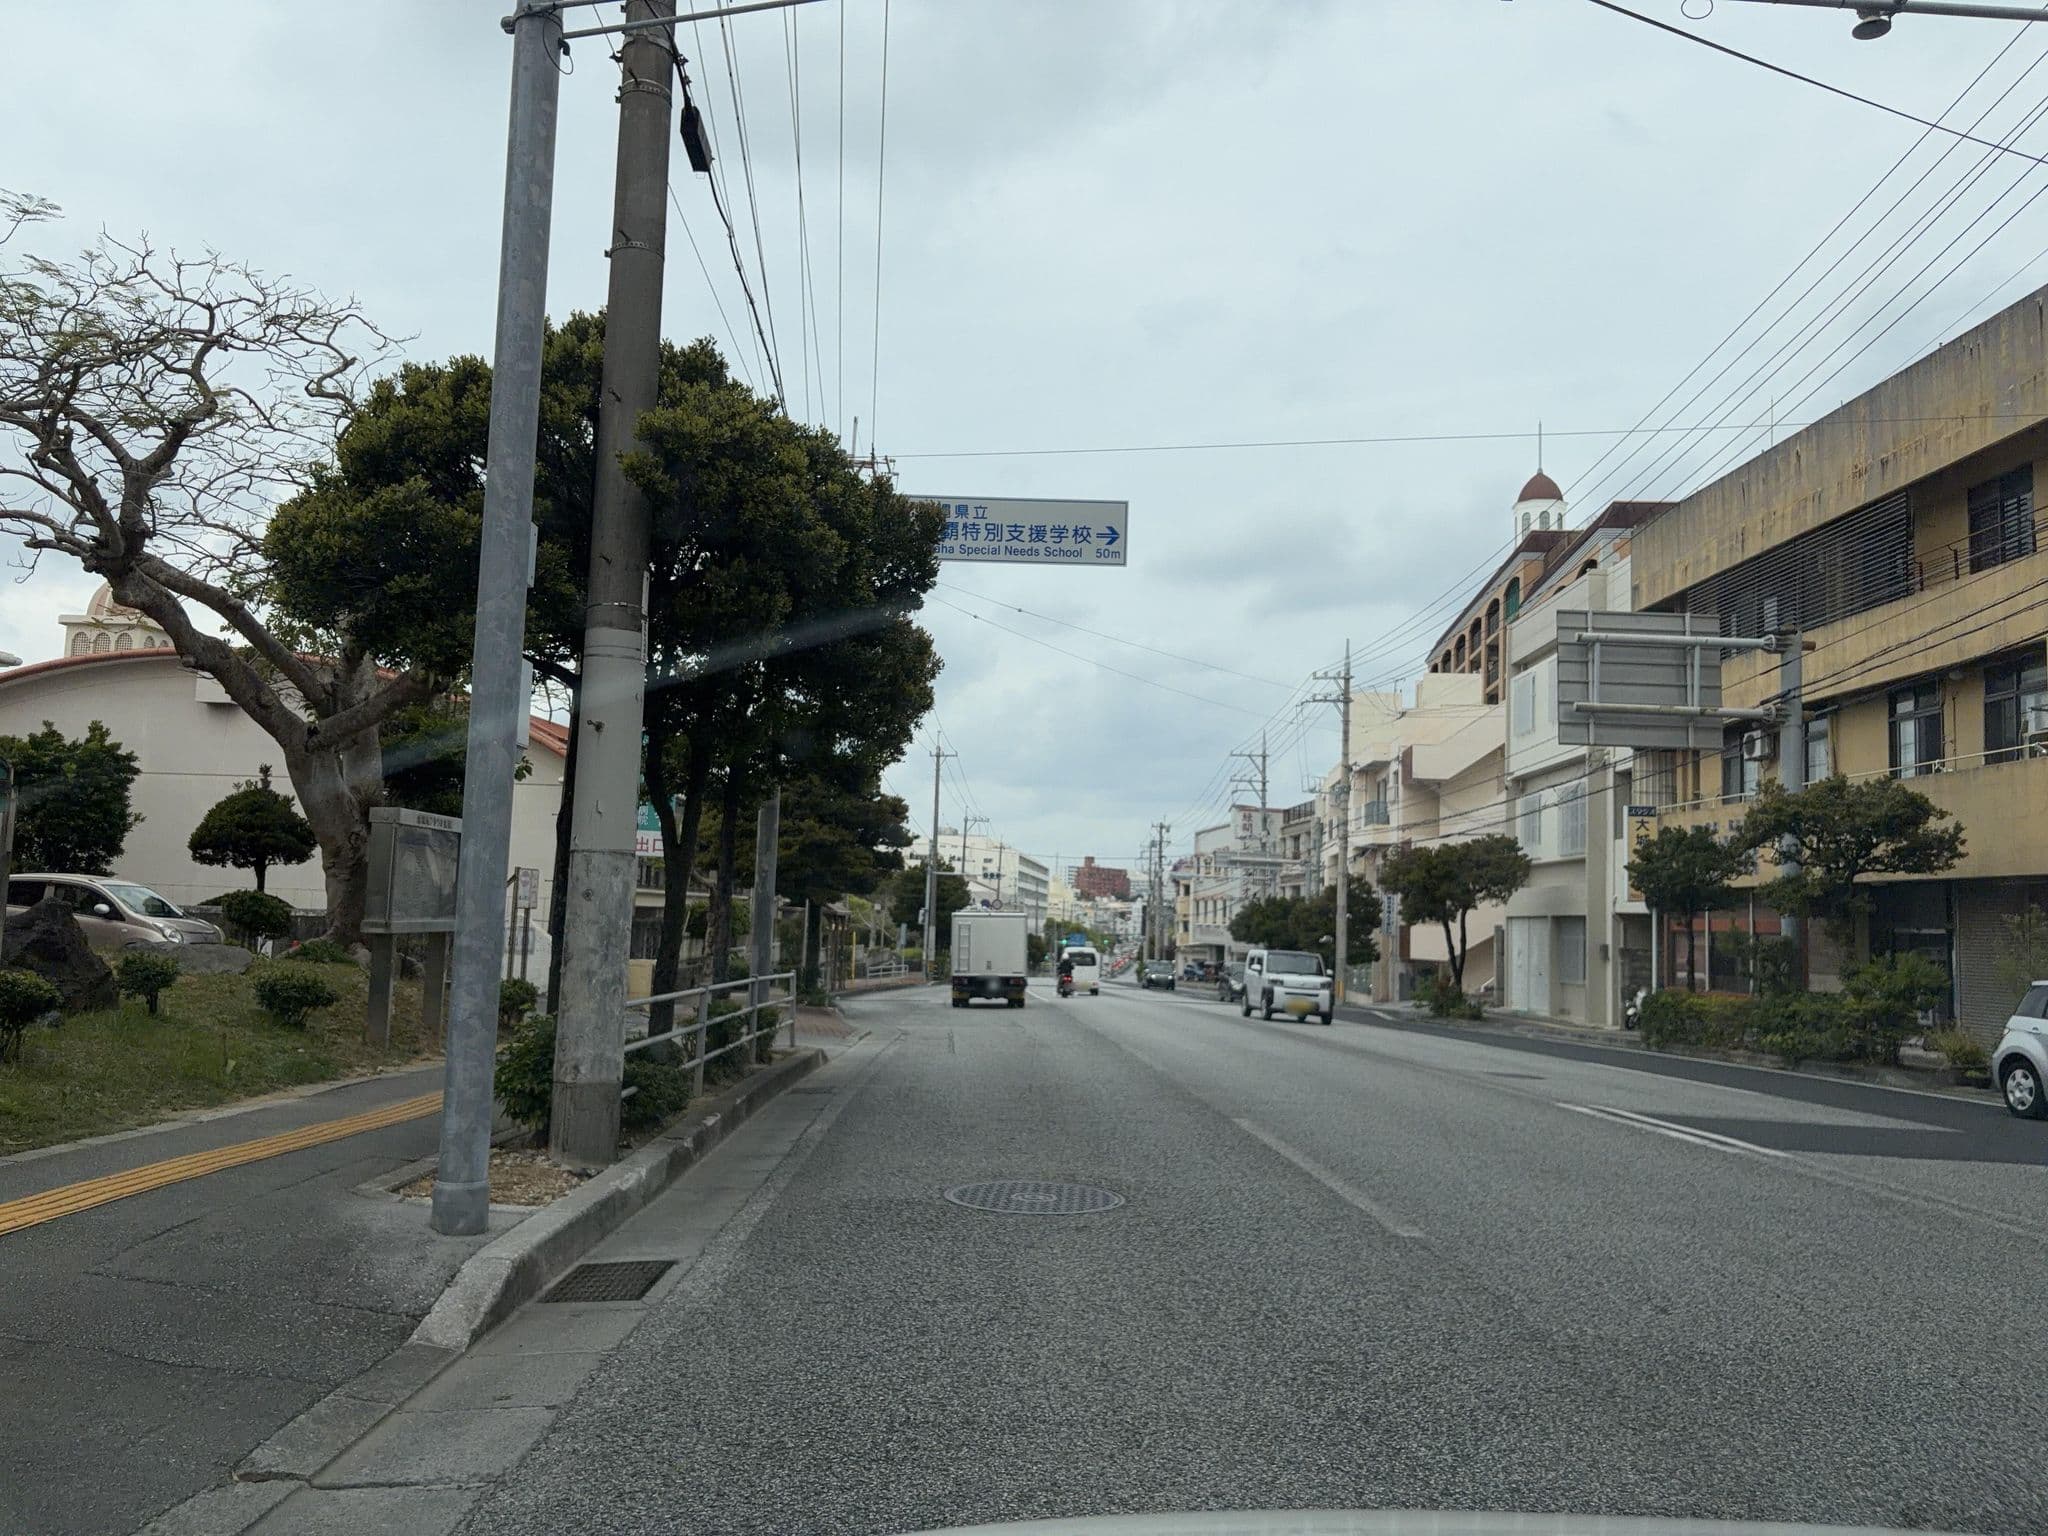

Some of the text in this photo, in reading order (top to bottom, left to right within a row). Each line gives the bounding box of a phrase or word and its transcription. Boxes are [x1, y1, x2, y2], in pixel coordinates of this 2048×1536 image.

[959, 544, 1001, 556] Special
[1004, 545, 1040, 557] Needs
[1044, 546, 1082, 558] School
[1095, 549, 1121, 559] 50m
